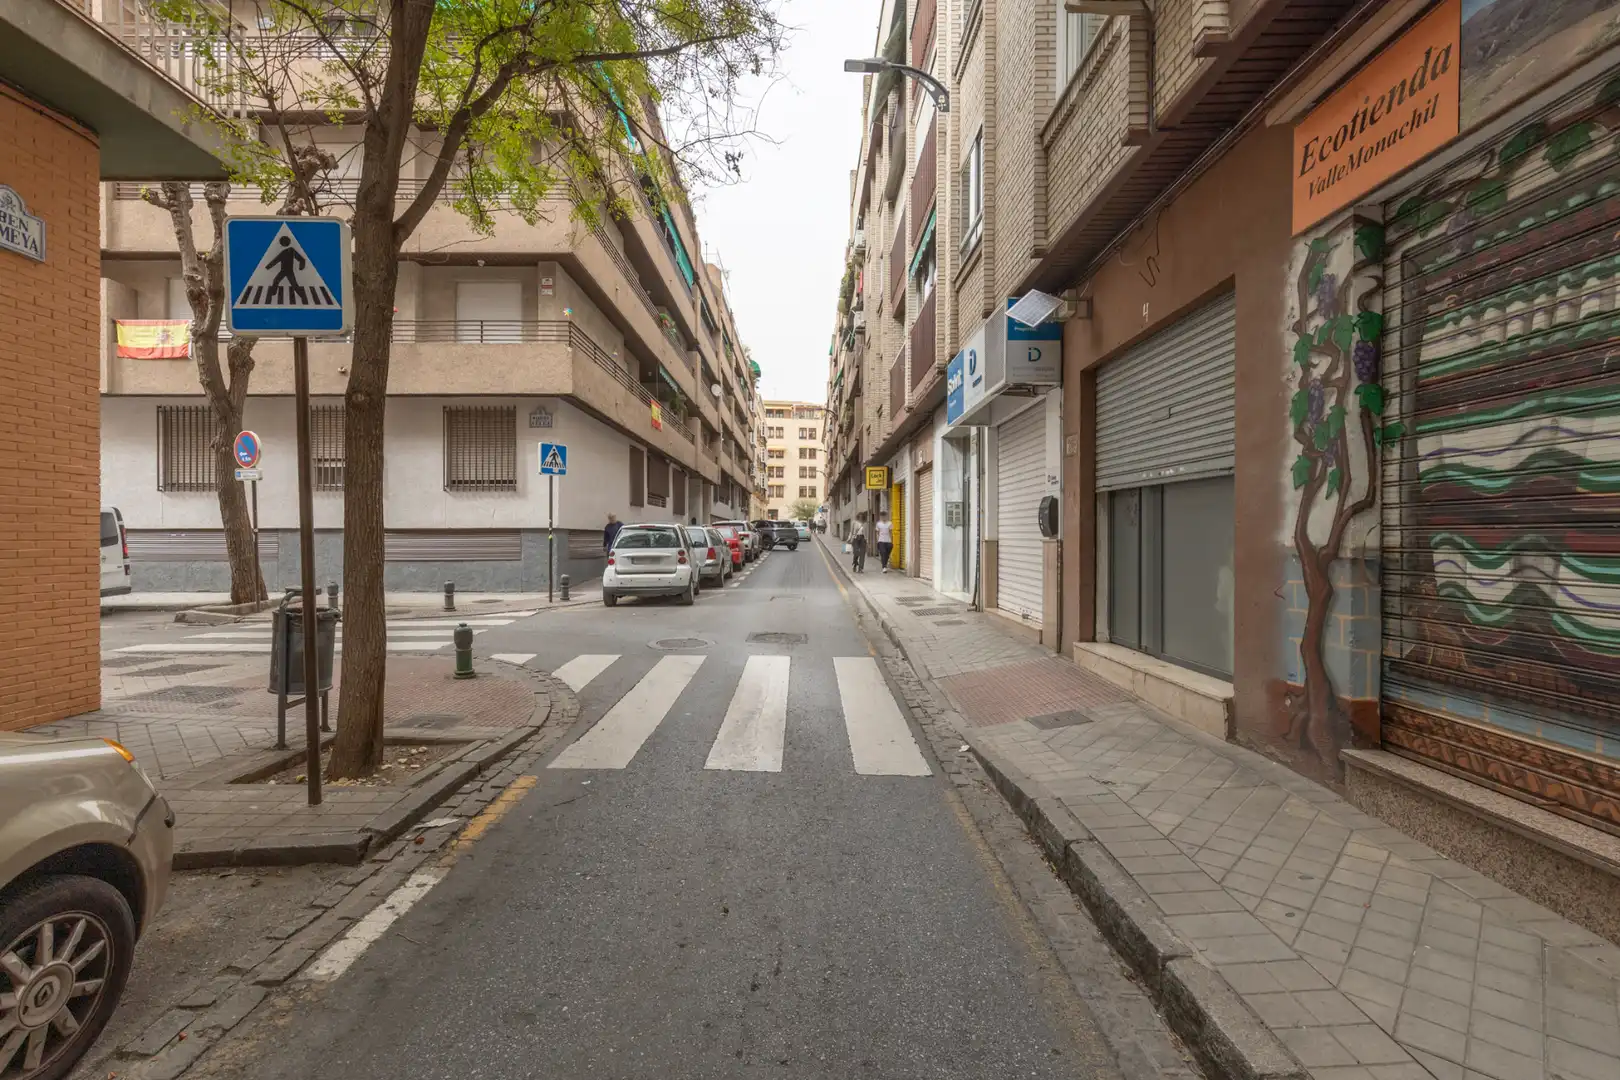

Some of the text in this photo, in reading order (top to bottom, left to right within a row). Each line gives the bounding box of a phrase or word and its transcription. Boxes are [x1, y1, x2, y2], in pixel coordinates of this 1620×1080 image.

[1298, 43, 1453, 178] Ecotienda
[1308, 93, 1440, 200] ValleMonachil
[0, 223, 40, 254] MEYA
